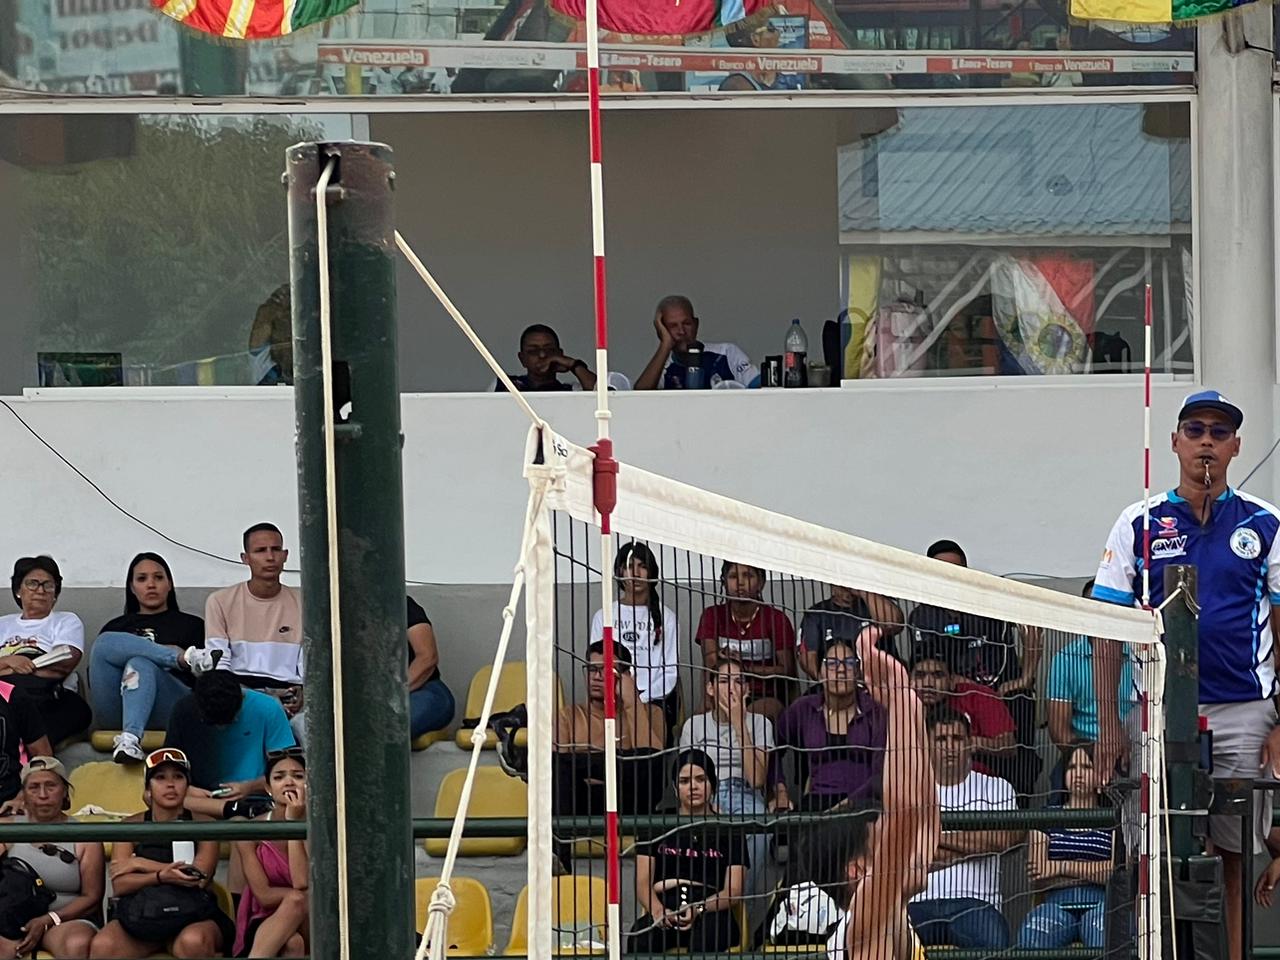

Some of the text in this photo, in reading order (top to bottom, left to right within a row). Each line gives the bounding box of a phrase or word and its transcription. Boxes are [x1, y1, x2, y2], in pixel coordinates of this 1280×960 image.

[342, 48, 424, 65] Venezuela
[758, 57, 818, 71] Venezuela
[1063, 58, 1111, 71] Venezuela
